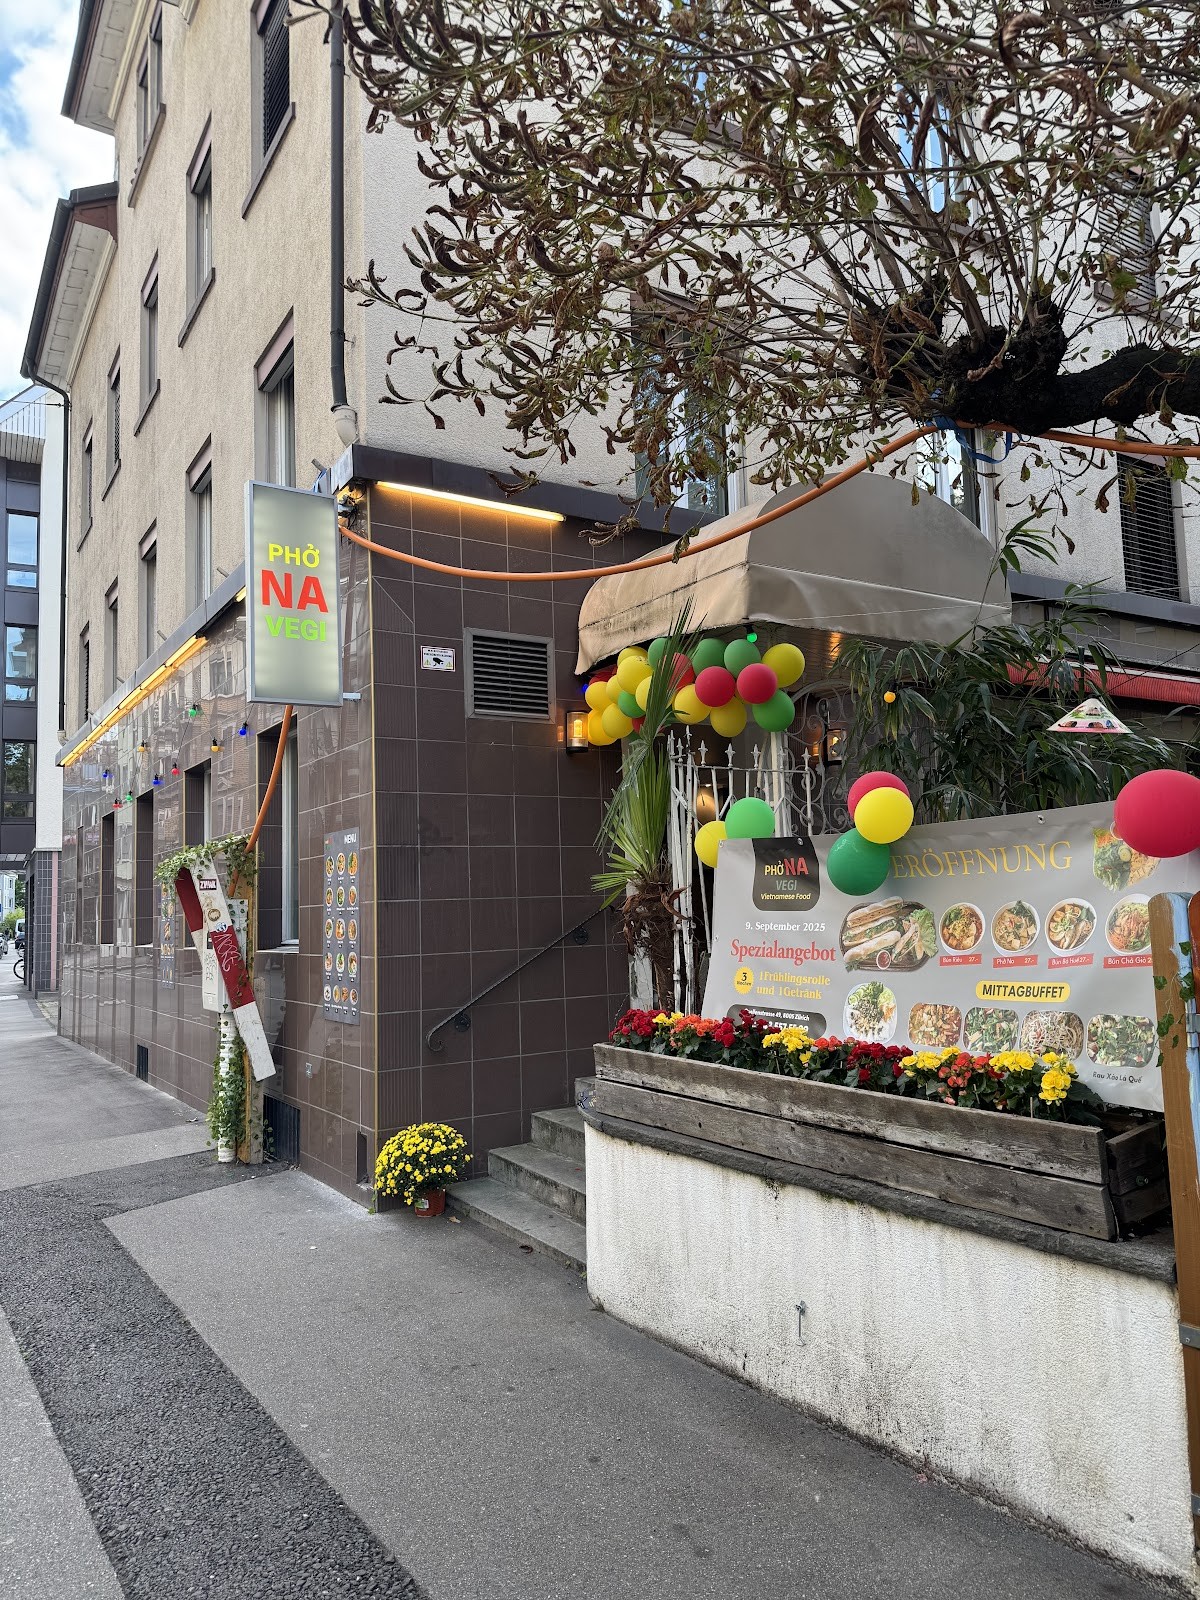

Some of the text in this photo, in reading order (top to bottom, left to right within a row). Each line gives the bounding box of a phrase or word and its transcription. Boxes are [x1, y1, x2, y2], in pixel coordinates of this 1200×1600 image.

[268, 543, 320, 568] PHỞ
[262, 570, 328, 613] NA
[265, 615, 326, 642] VEGI
[344, 833, 357, 844] MENU
[764, 857, 809, 876] PHỞ NA
[776, 880, 797, 890] VEGI
[745, 922, 826, 932] 9. September 2025
[731, 939, 836, 966] Spezialangebot
[741, 972, 747, 981] 3
[764, 972, 830, 985] Frühlingsrolle
[756, 986, 774, 995] und
[783, 987, 822, 999] Getränk
[982, 984, 1065, 998] MITTAGBUFFET
[795, 1013, 810, 1021] Zürich
